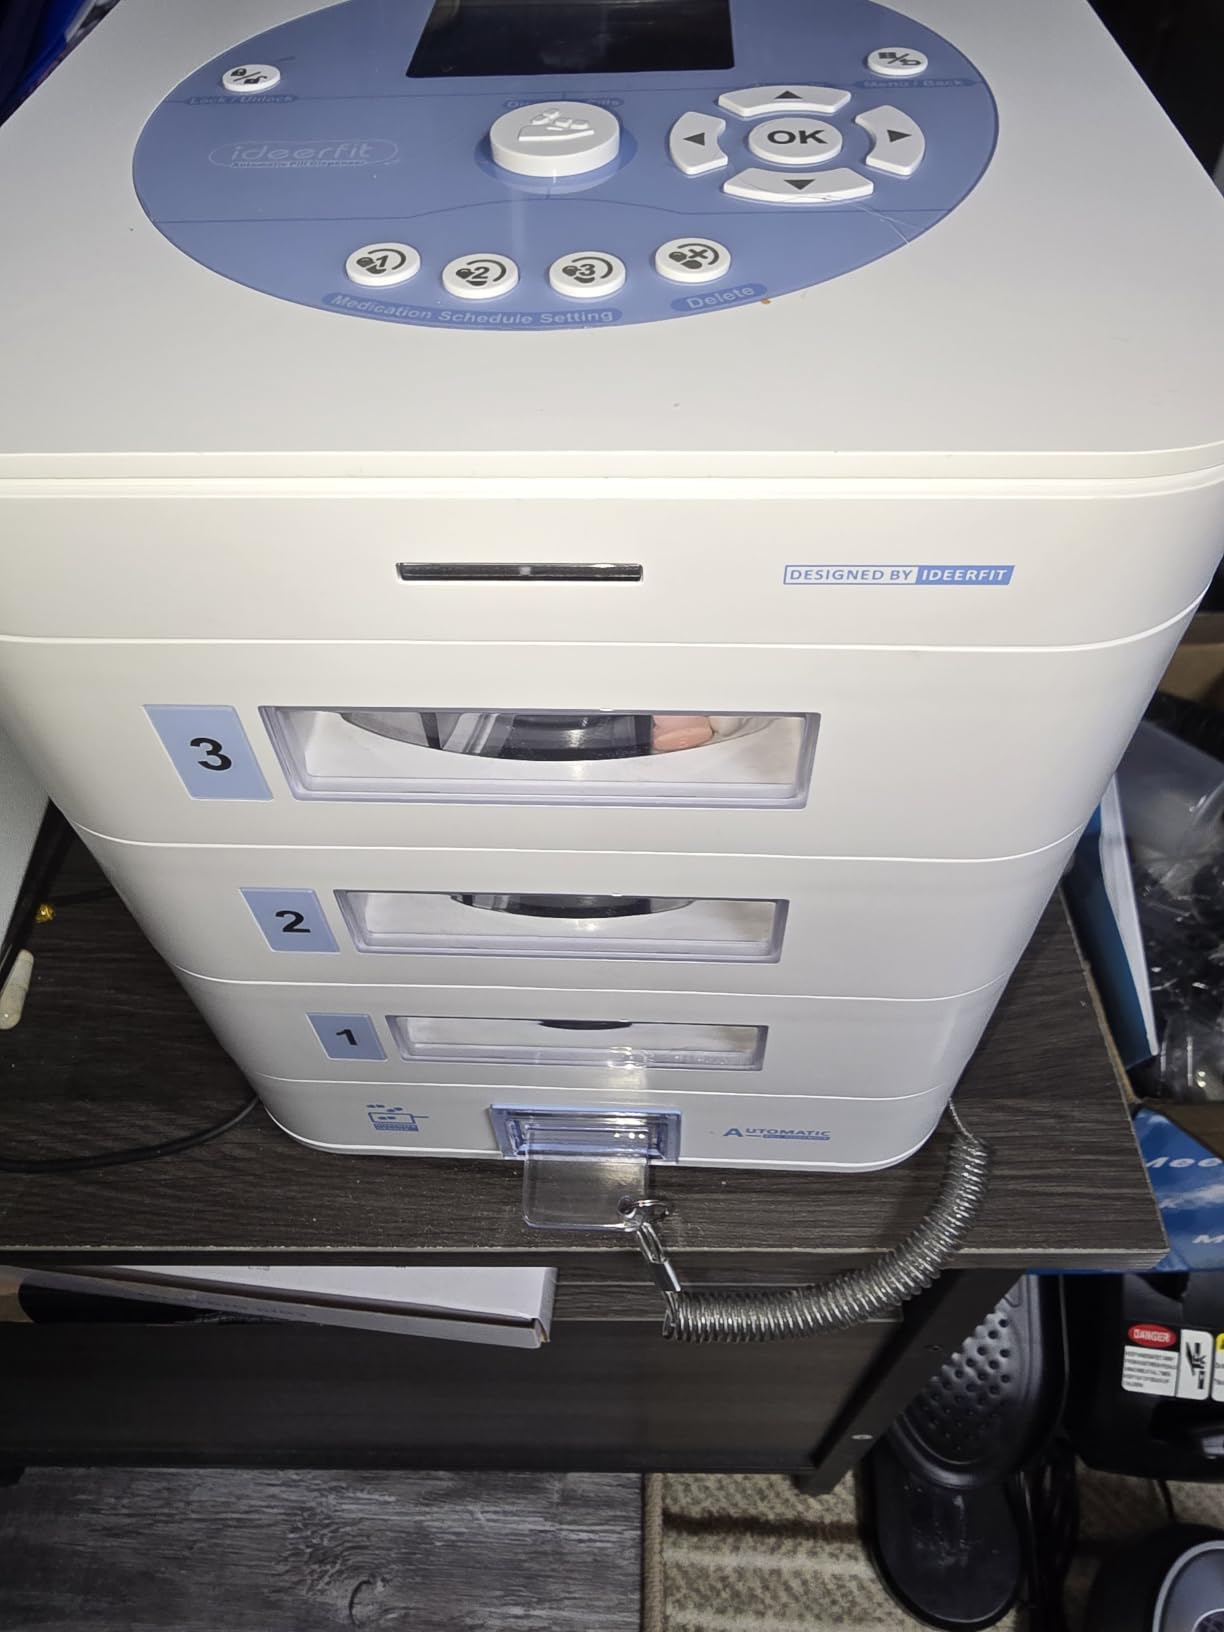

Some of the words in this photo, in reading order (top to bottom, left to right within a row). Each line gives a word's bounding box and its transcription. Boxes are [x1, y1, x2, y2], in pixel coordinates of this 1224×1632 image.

[767, 129, 829, 144] OK
[231, 143, 374, 161] ideerfit
[376, 255, 389, 268] 1
[580, 263, 596, 276] 3
[471, 266, 490, 280] 2
[686, 287, 754, 308] Delete
[331, 295, 431, 319] Medication
[437, 310, 533, 325] Schedule
[539, 310, 613, 324] Setting
[789, 568, 884, 582] DESIGNED
[889, 568, 913, 582] BY
[921, 568, 1008, 582] IDEERFIT
[190, 737, 233, 772] 3
[275, 910, 312, 934] 2
[335, 1028, 358, 1046] 1
[722, 1127, 832, 1138] AUTOMATIC
